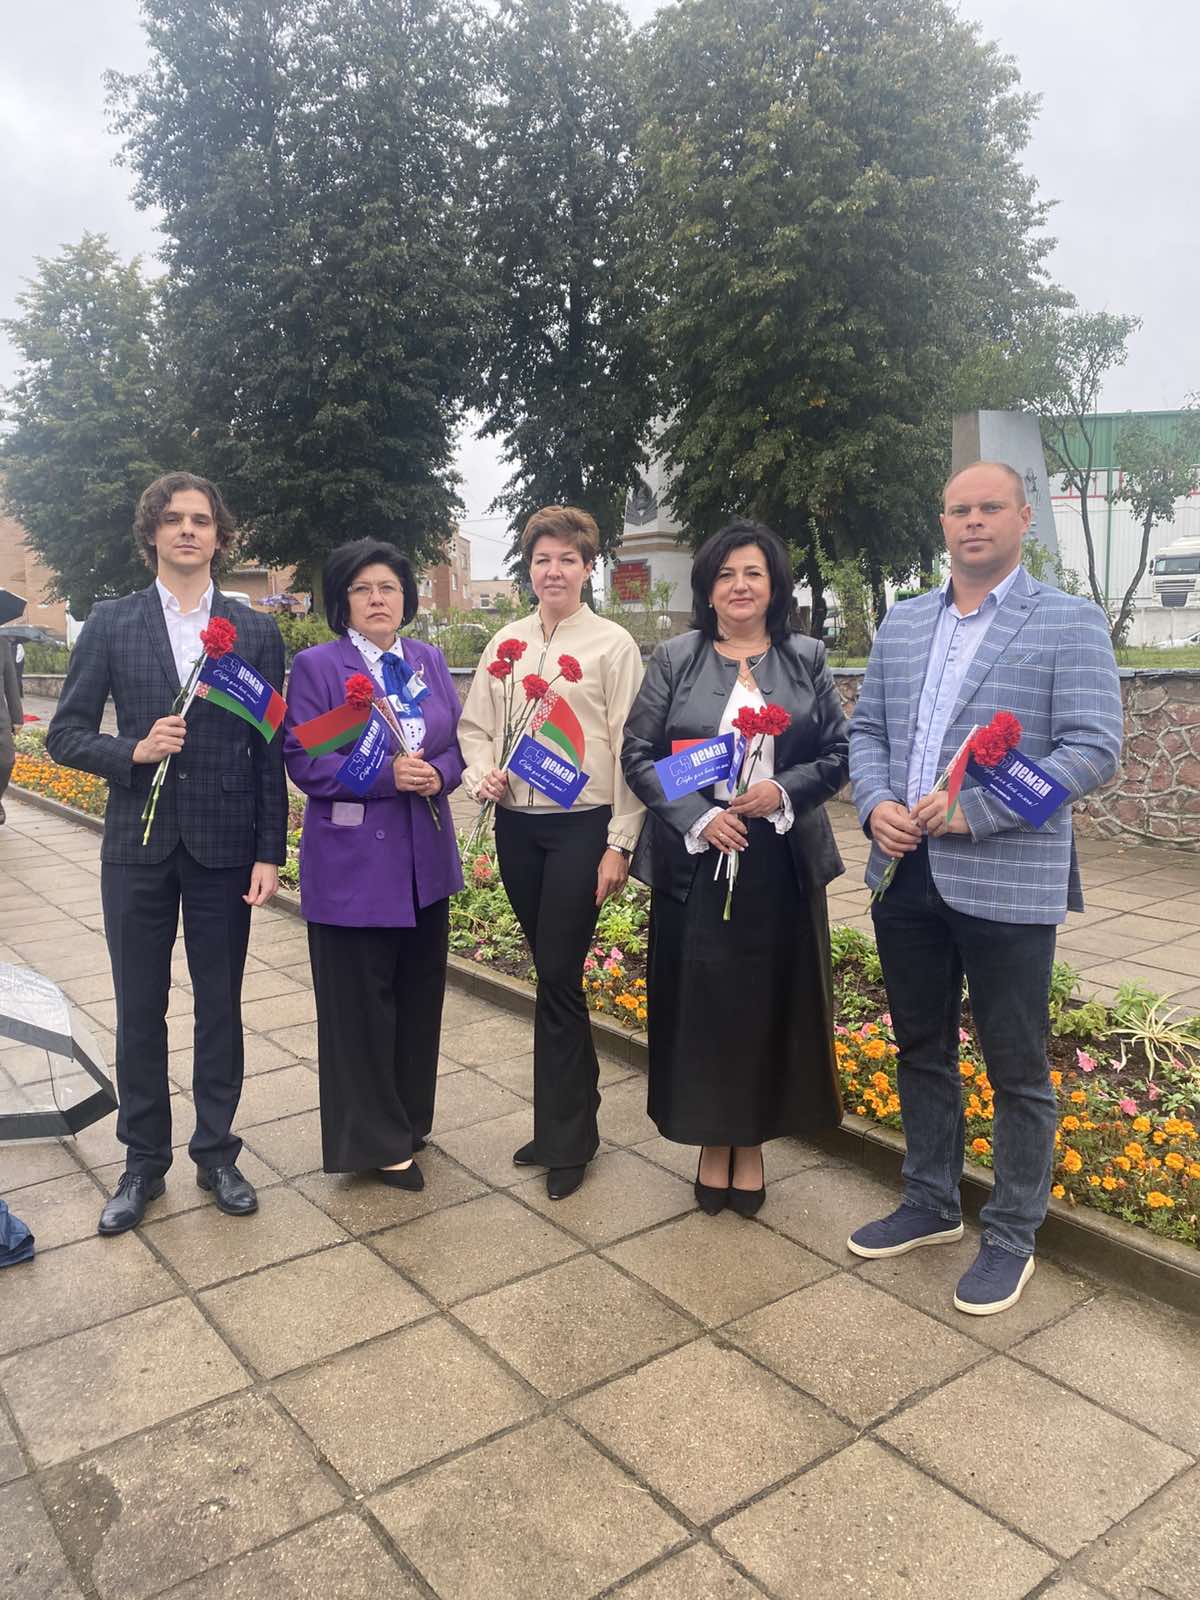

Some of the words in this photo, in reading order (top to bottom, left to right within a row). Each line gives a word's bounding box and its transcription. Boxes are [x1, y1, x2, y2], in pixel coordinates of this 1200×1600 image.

[237, 666, 264, 696] Неман
[360, 720, 380, 757] Неман
[690, 742, 728, 767] Неман
[541, 756, 576, 784] Неман
[1008, 760, 1052, 797] Неман
